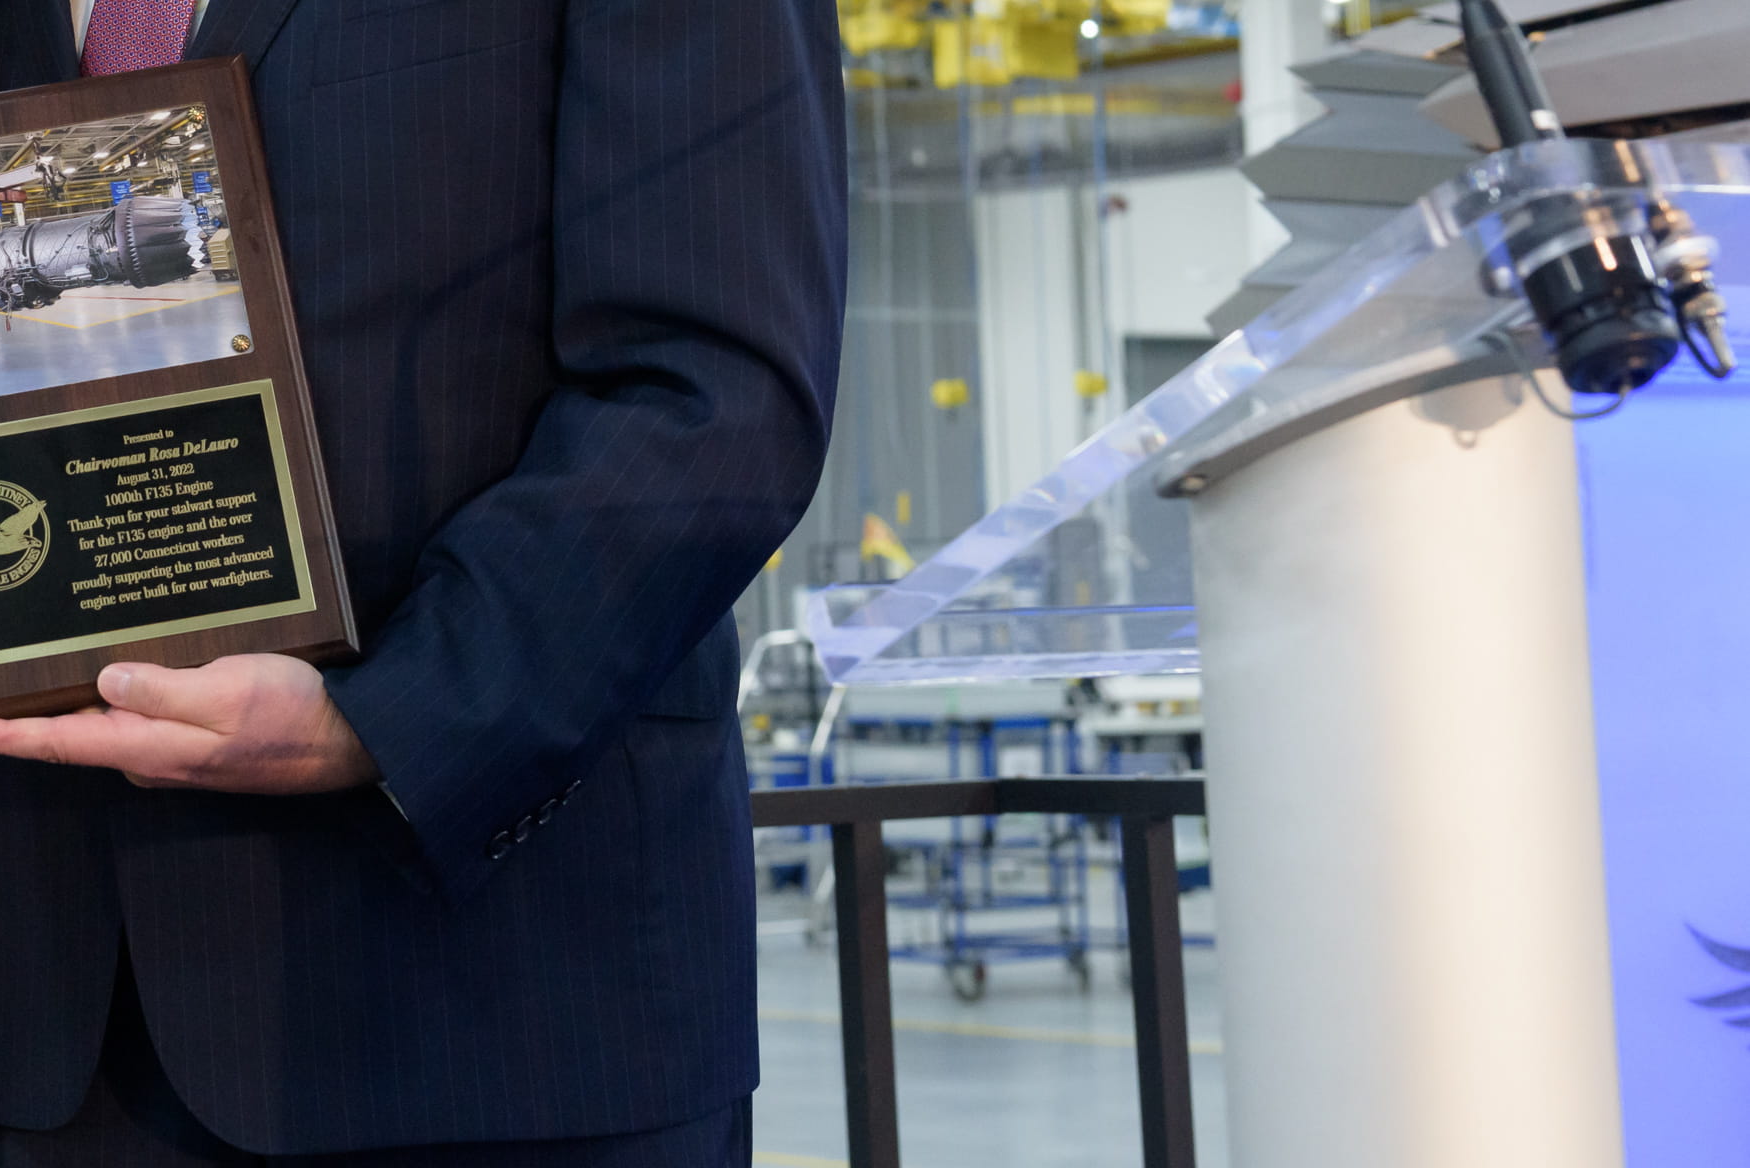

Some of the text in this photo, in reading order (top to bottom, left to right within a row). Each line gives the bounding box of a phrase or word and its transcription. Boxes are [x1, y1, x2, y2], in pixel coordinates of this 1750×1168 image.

[123, 429, 174, 445] Presented to
[65, 437, 239, 475] Chairwoman Rosa DeLauro
[117, 463, 195, 486] August 31, 2022
[105, 480, 214, 507] 1000th F135 Engine
[67, 492, 257, 532] Thank you for your stalwart support
[79, 513, 252, 550] for the F135 engine and the over
[9, 548, 41, 582] ENGINES
[94, 533, 245, 568] 27,000 Connecticut workers
[71, 546, 274, 594] proudly supporting the most advanced
[80, 569, 273, 610] engine ever built for our warfighters.
